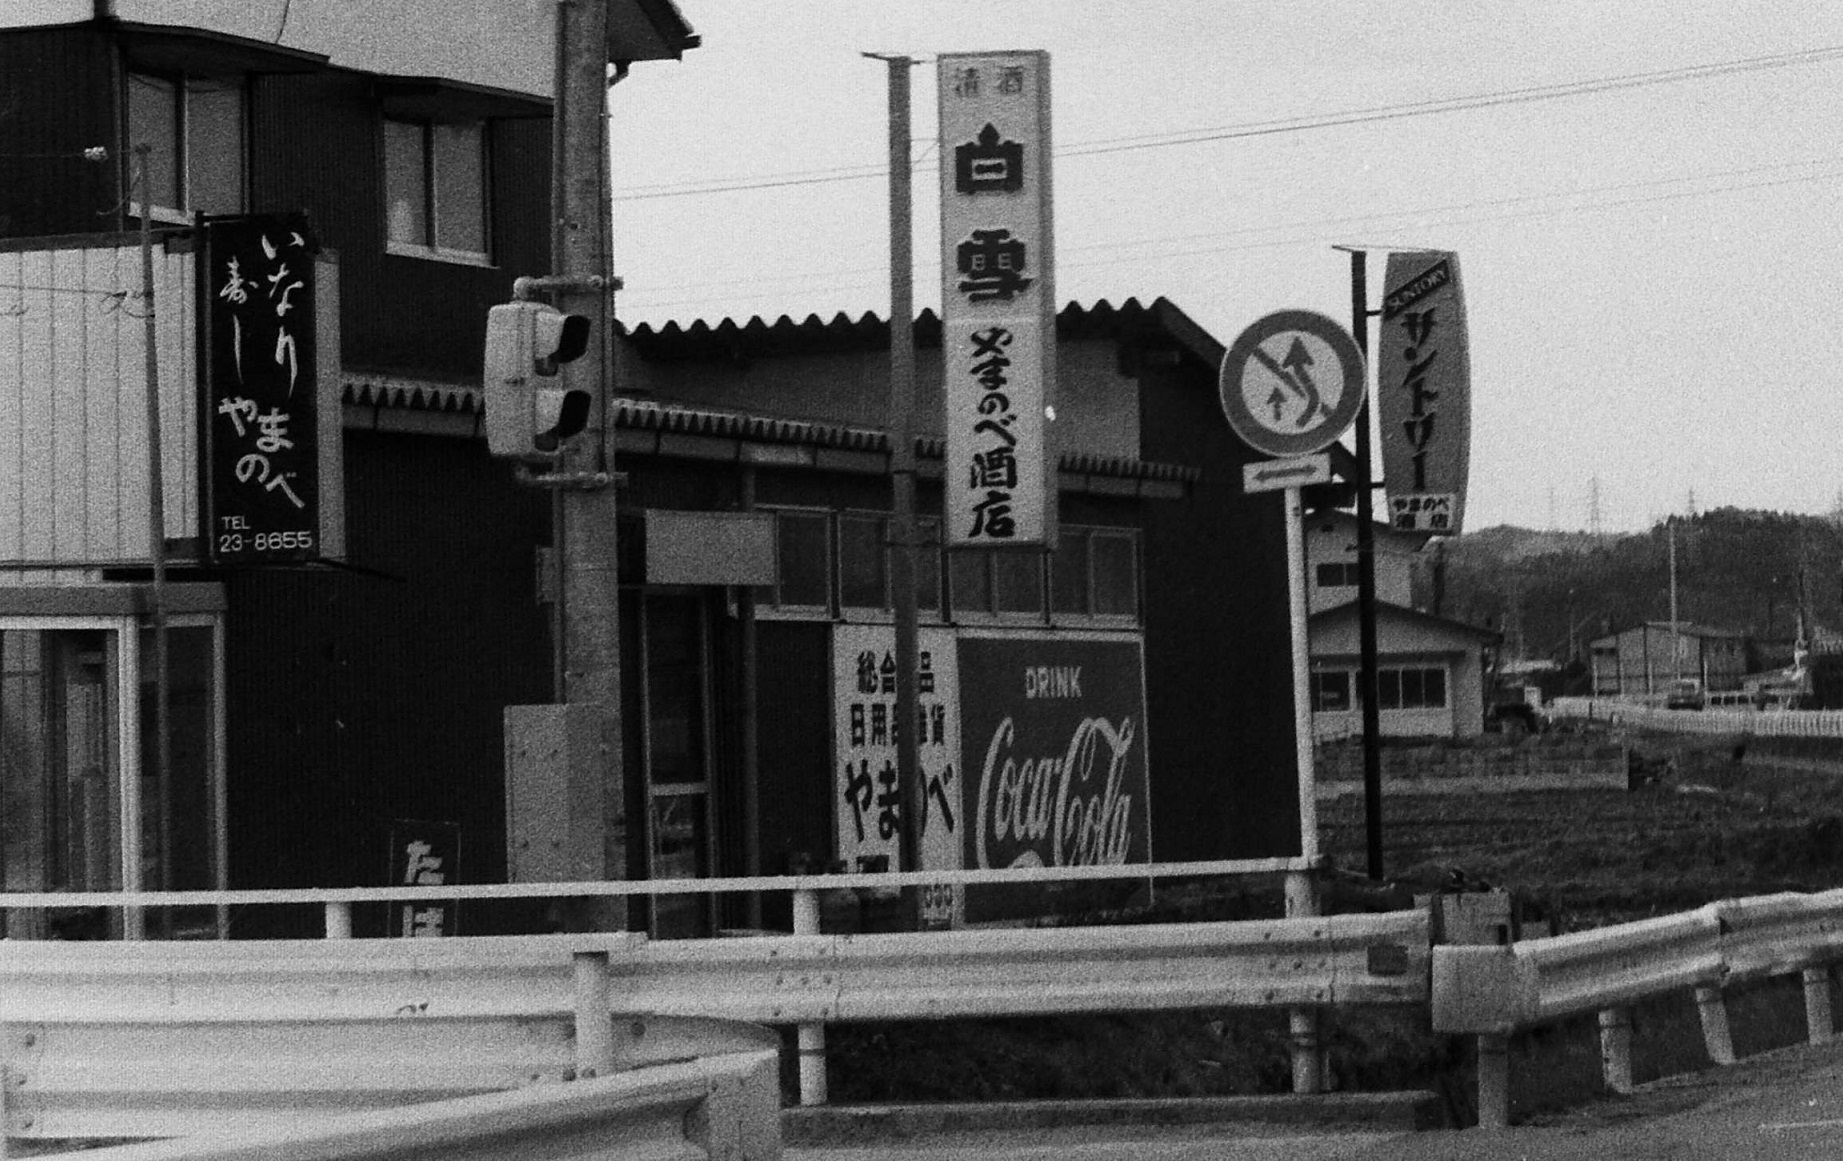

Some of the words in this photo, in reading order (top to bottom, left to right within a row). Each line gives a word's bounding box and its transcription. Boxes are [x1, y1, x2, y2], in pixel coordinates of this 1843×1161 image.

[955, 123, 1033, 301] 白雪
[261, 231, 305, 399] いなり
[1386, 269, 1447, 313] SUNTORY
[1400, 306, 1439, 491] サントリー
[218, 396, 305, 508] やまのべ
[221, 516, 251, 530] TEL
[858, 650, 935, 694] 総合品
[1025, 666, 1082, 699] DRINK
